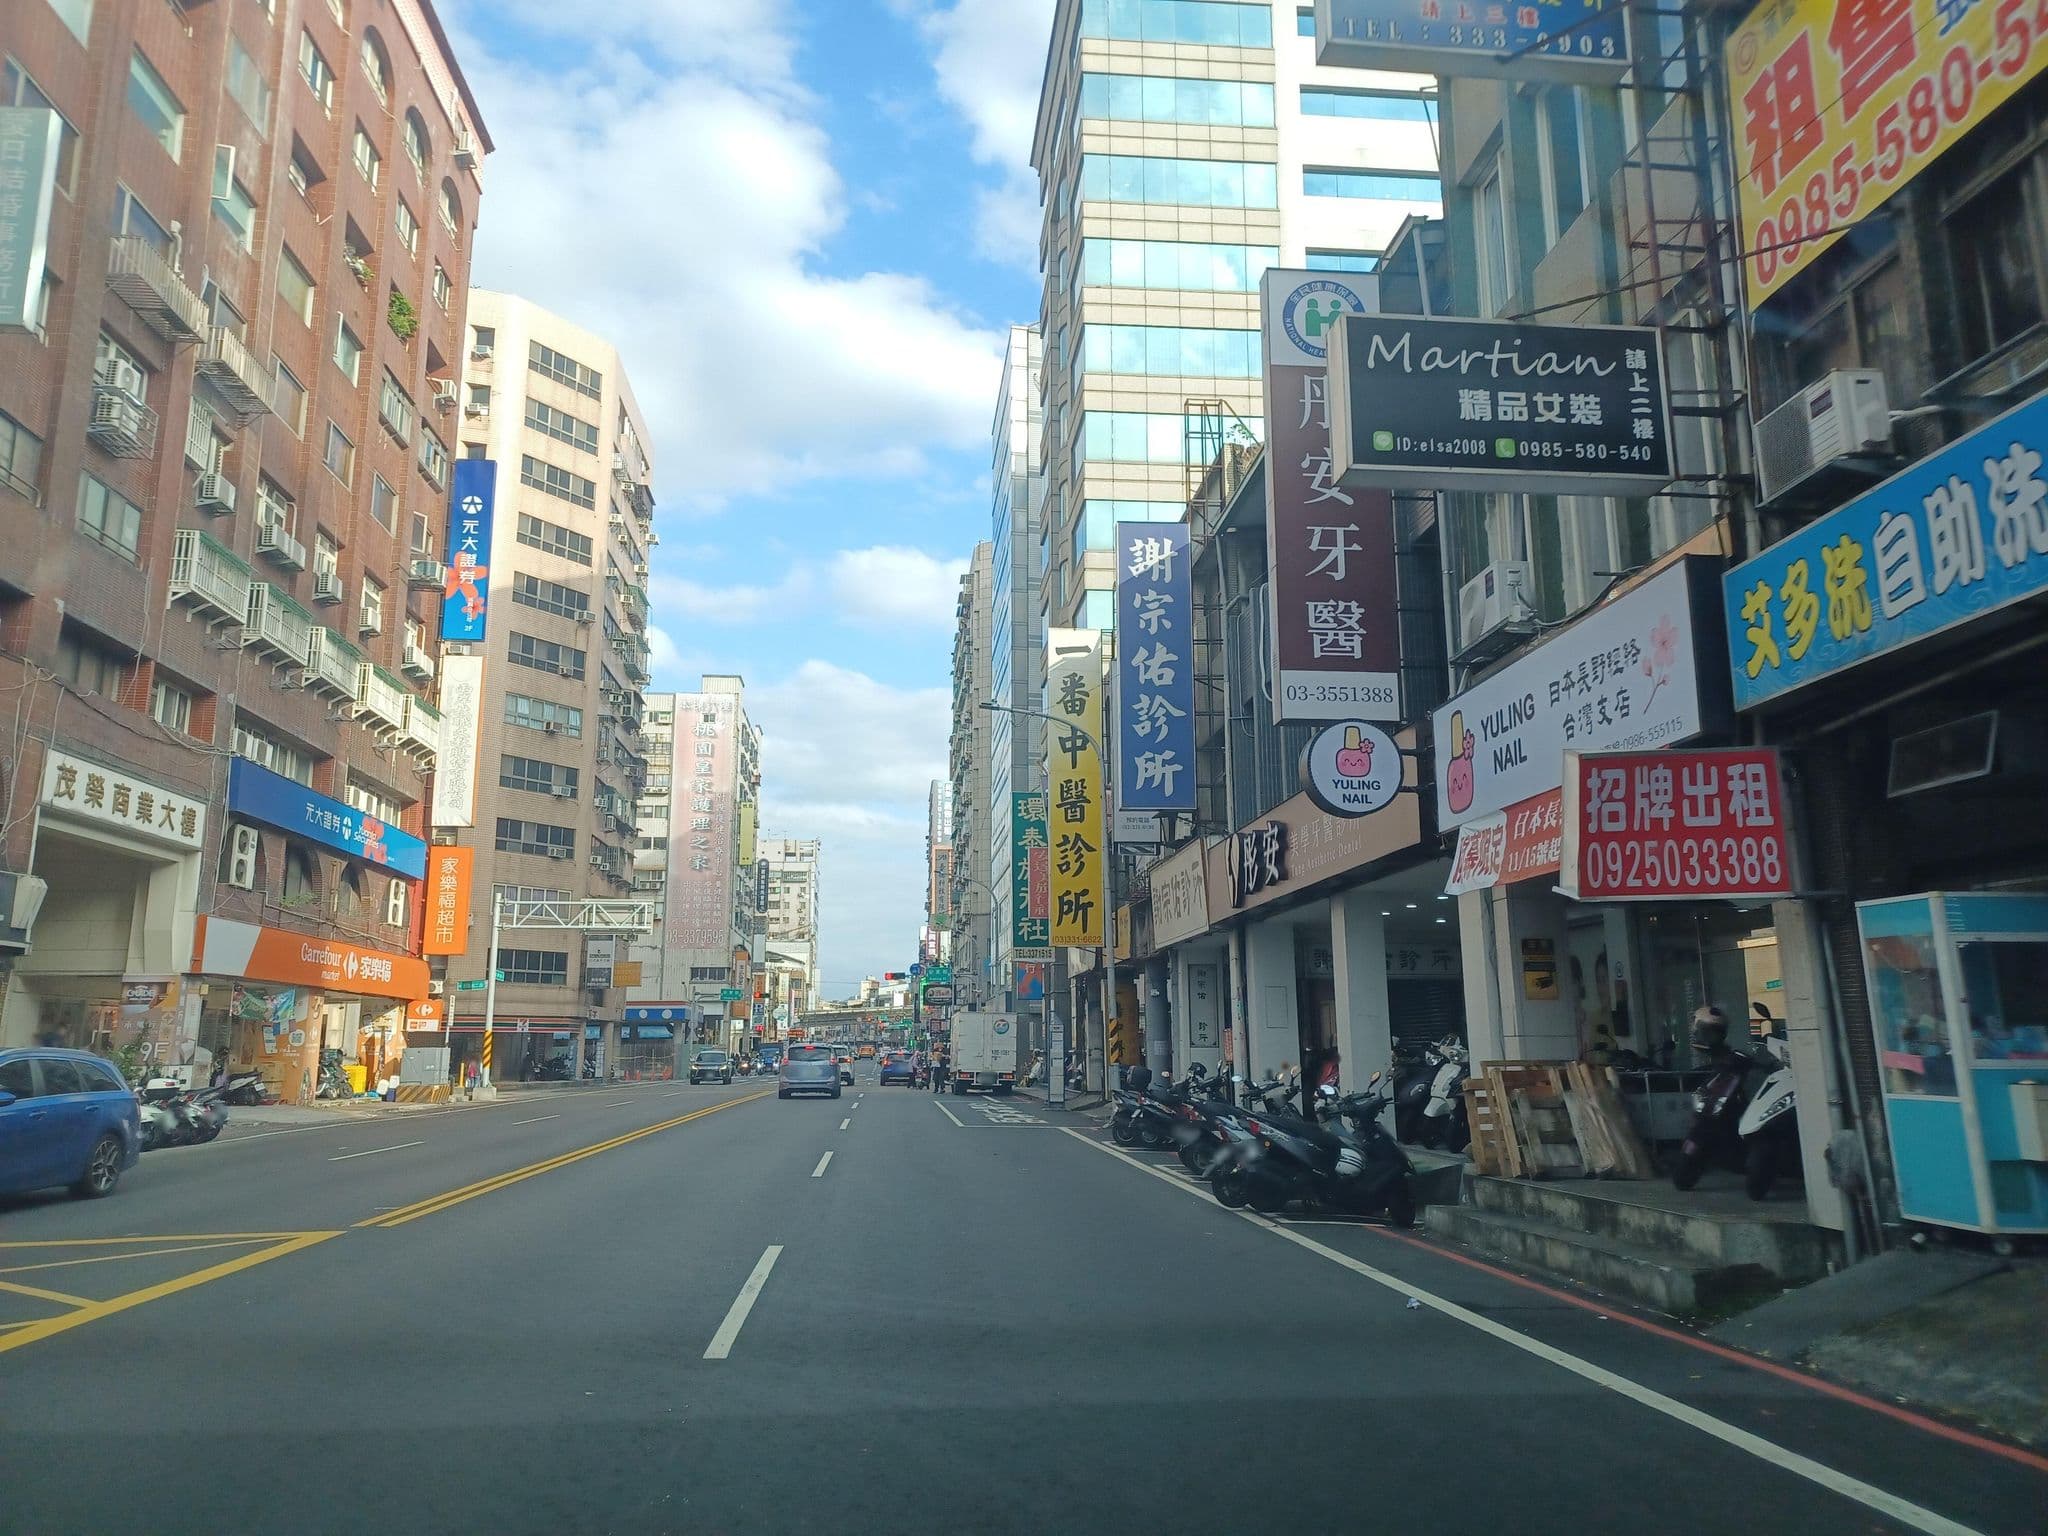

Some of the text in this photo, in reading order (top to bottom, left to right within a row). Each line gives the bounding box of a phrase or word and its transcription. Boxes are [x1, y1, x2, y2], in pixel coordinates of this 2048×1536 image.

[1755, 0, 2048, 286] 0985-580-5
[1308, 345, 1327, 357] HEA
[1367, 331, 1617, 379] Martian
[1458, 388, 1603, 426] 精品女裝
[1624, 347, 1655, 441] 請上二樓
[1397, 437, 1487, 456] ID:elsa2008
[1519, 441, 1652, 462] 0985-580-540
[459, 519, 480, 585] 元大證券
[1128, 537, 1188, 798] 謝宗佑診所
[1550, 638, 1641, 708] 日本長野經絡
[1286, 684, 1394, 704] 03-3551388
[1562, 686, 1631, 742] 台灣支店
[1480, 692, 1536, 743] YULING
[1493, 741, 1528, 775] NAIL
[53, 762, 197, 839] 茂榮商業大樓
[1055, 644, 1098, 934] 一番中醫診所
[1331, 778, 1381, 791] YULING
[1342, 792, 1373, 805] NAIL
[1586, 762, 1775, 833] 招牌出租
[305, 802, 341, 834] 元大證券
[1514, 798, 1562, 840] 日本長
[1586, 836, 1782, 888] 0925033388
[436, 856, 460, 944] 家樂福超市
[301, 942, 342, 967] Carrefour
[360, 956, 392, 983] 家樂福
[141, 1041, 170, 1062] 9F
